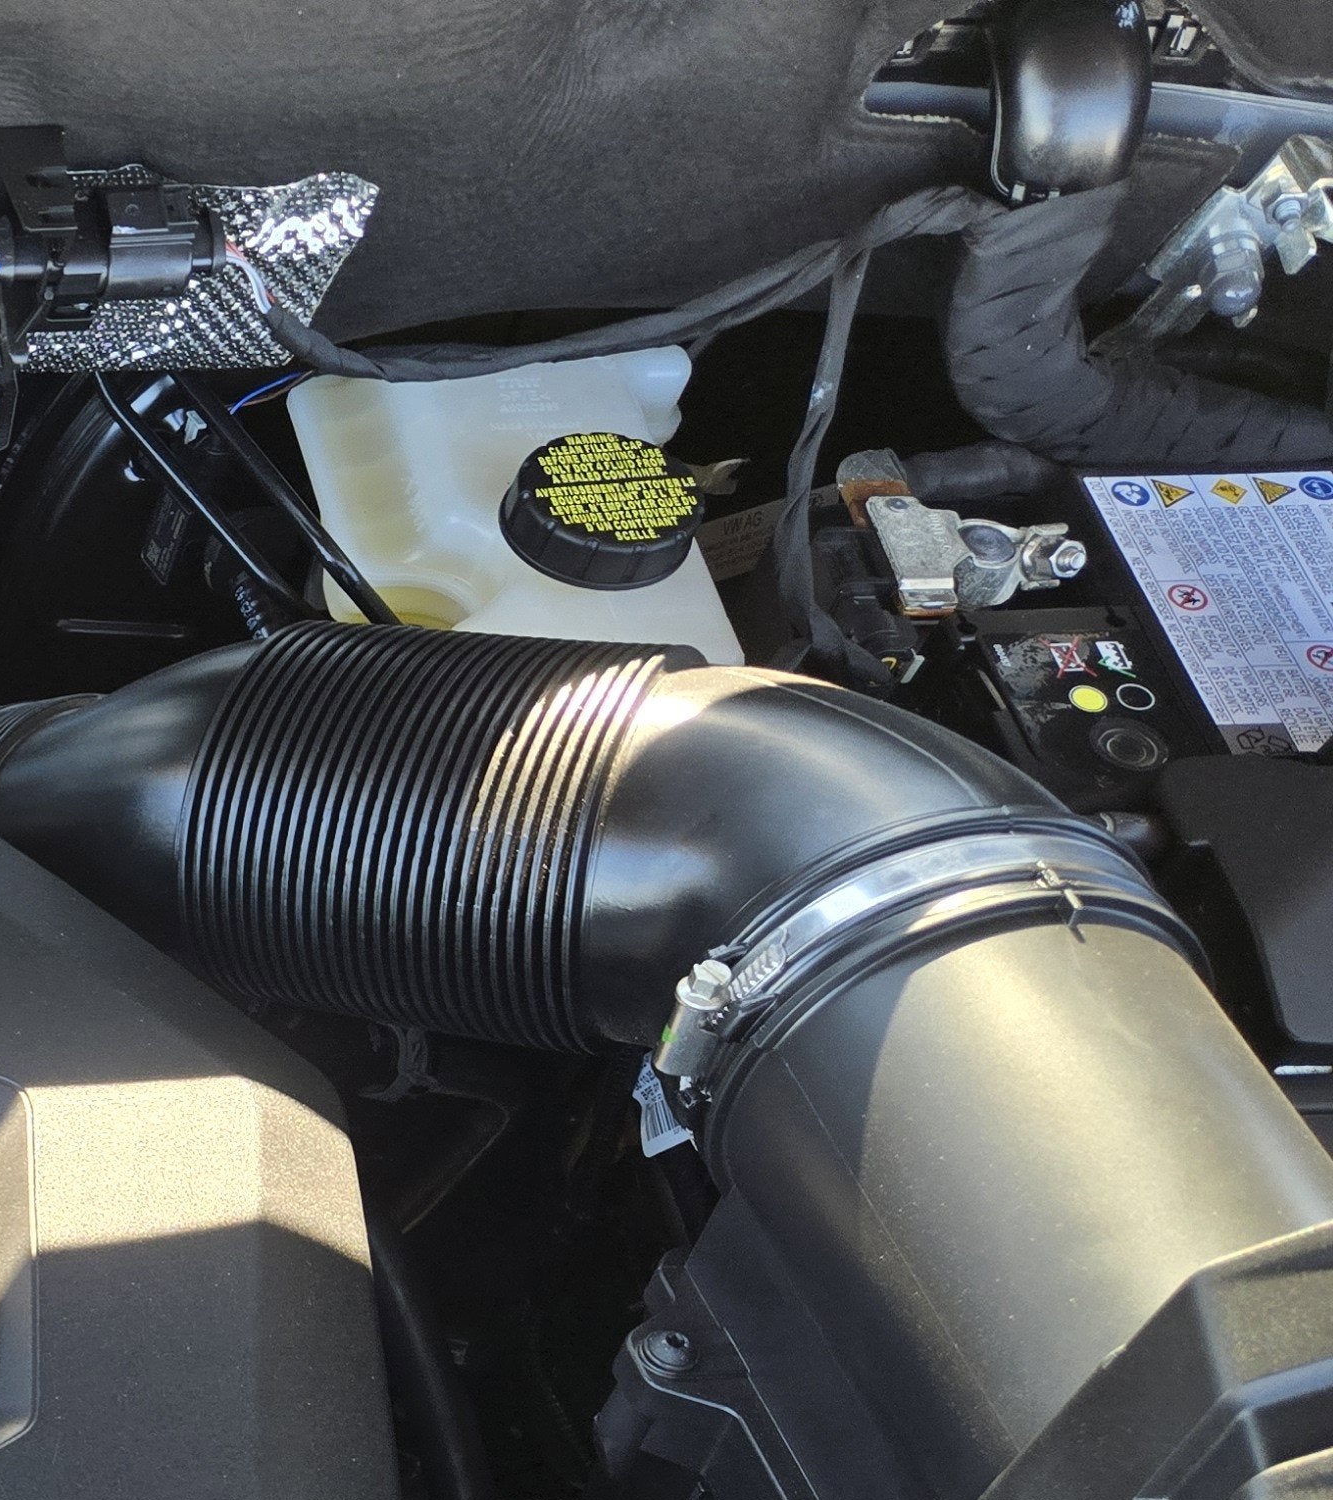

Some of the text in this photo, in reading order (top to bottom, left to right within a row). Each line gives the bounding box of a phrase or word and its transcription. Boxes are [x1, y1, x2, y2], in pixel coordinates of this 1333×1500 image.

[565, 434, 618, 445] WARNING:
[548, 441, 643, 456] CLEAN FILLER CAP
[538, 455, 580, 467] BEFORE
[642, 448, 663, 459] USE
[544, 464, 571, 476] ONLY
[573, 462, 594, 472] DOT
[605, 460, 635, 470] FLUID
[636, 457, 667, 467] FROM
[551, 467, 667, 484] A SEALED CONTAINER.
[626, 479, 680, 493] NETTOYER
[681, 477, 696, 487] LE
[550, 492, 604, 507] BOUCHON
[606, 491, 640, 503] AVANT
[643, 489, 658, 499] DE
[656, 497, 679, 508] QUE
[681, 496, 697, 506] DU
[561, 513, 604, 525] LIQUIDE
[633, 507, 693, 519] PROVENANT
[614, 517, 679, 530] CONTENANT
